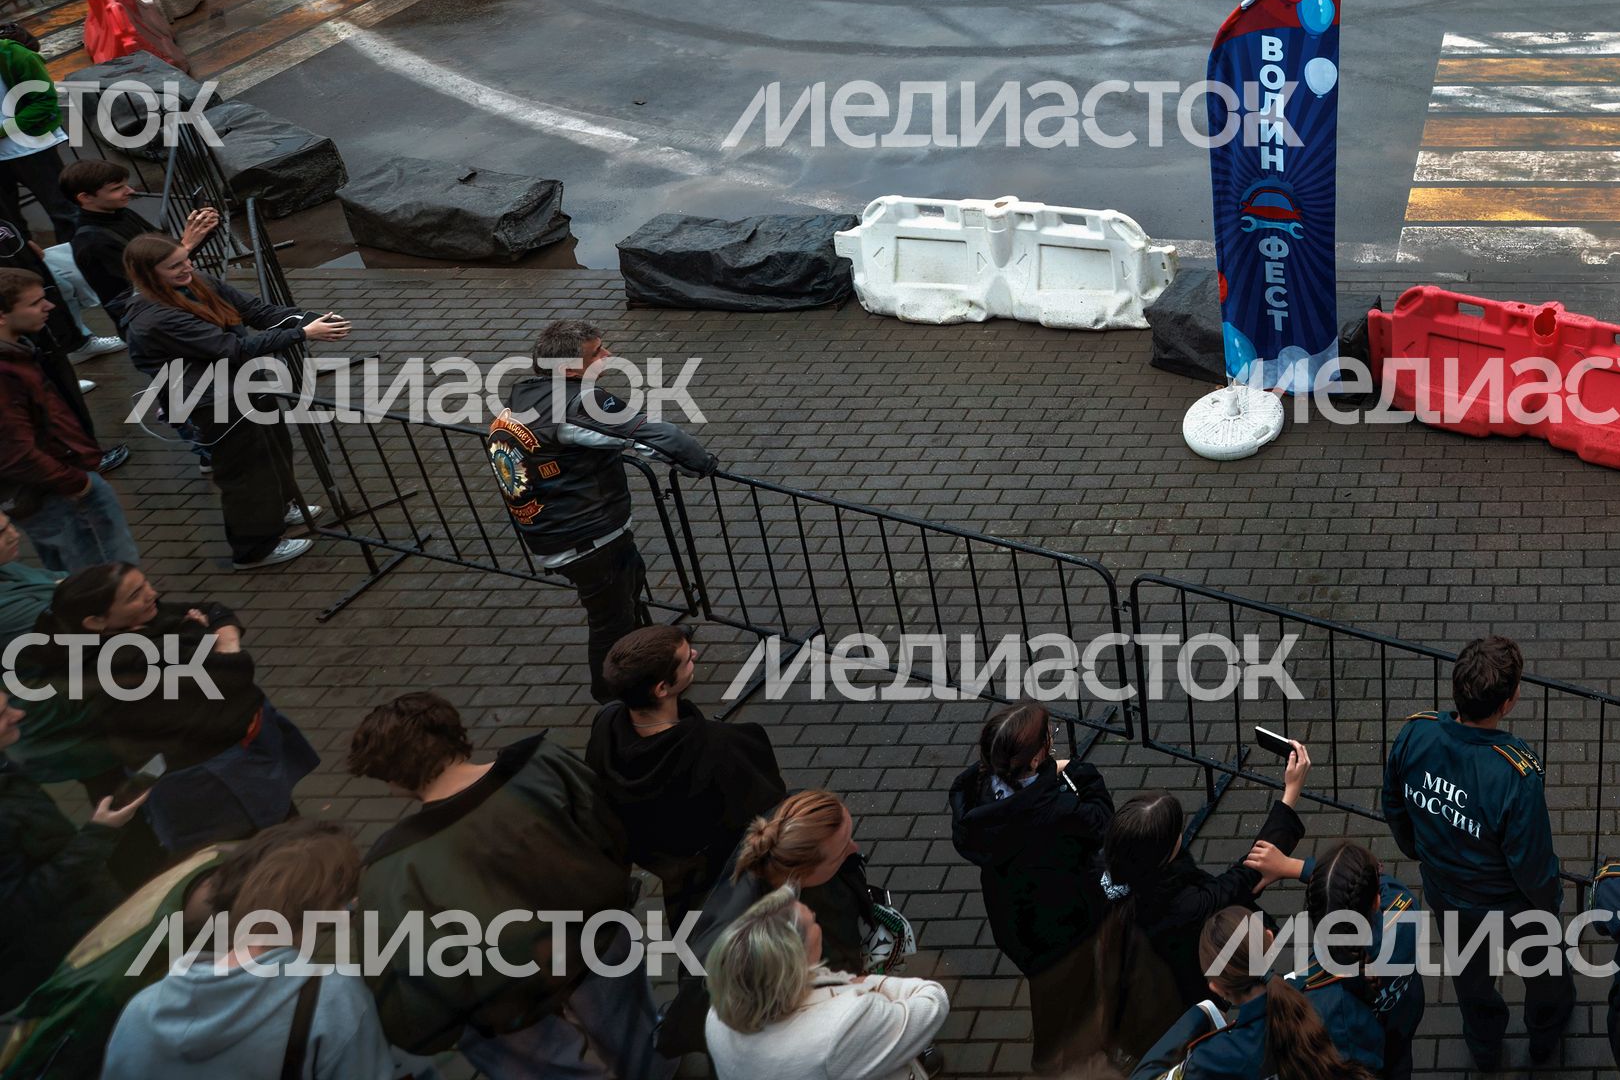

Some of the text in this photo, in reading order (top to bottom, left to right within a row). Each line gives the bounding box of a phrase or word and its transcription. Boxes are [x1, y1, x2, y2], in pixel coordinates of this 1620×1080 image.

[1258, 35, 1290, 332] ВОЛИН ФЕСТ
[1404, 783, 1481, 839] РОССИИ
[1422, 771, 1468, 808] МЧС
